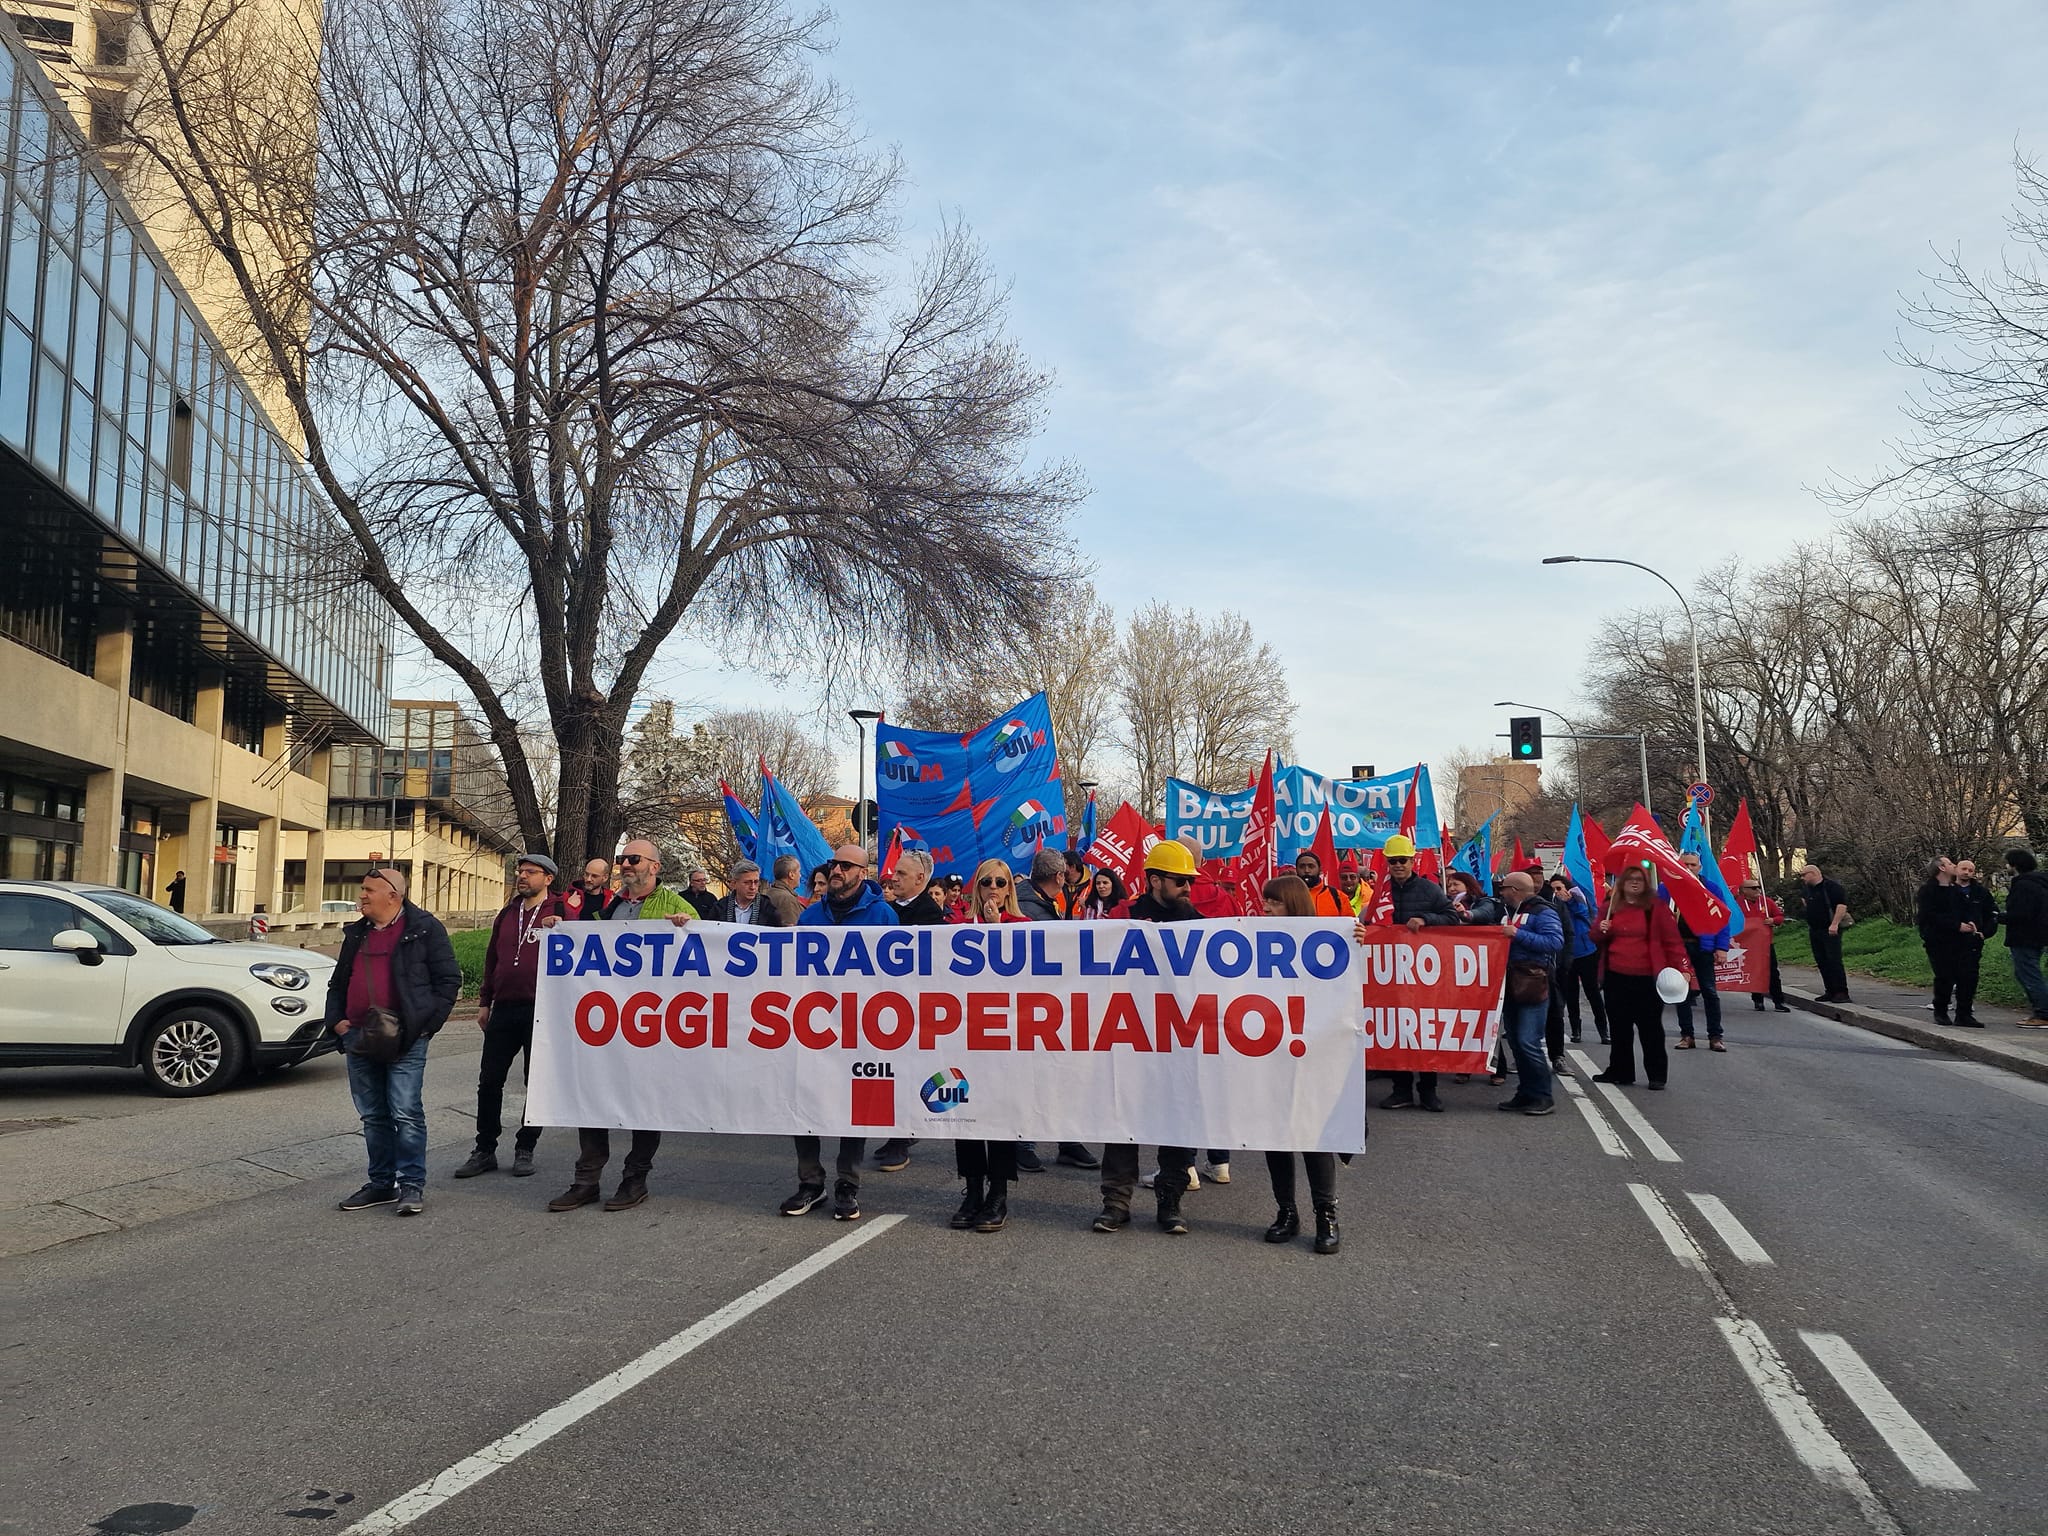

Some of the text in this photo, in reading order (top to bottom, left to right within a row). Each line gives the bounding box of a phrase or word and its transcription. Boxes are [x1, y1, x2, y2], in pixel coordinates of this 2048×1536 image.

[1002, 729, 1048, 759] UILM
[884, 761, 945, 784] UILM
[1178, 774, 1423, 820] BASA MORTI
[1020, 814, 1066, 844] UILM
[1177, 824, 1234, 851] SUL
[546, 928, 1351, 979] BASTA STRAGI SUL LAVORO
[1454, 944, 1489, 988] DI
[574, 990, 1308, 1058] OGGI SCIOPERIAMO!
[851, 1061, 895, 1078] CGIL
[938, 1087, 969, 1103] UIL
